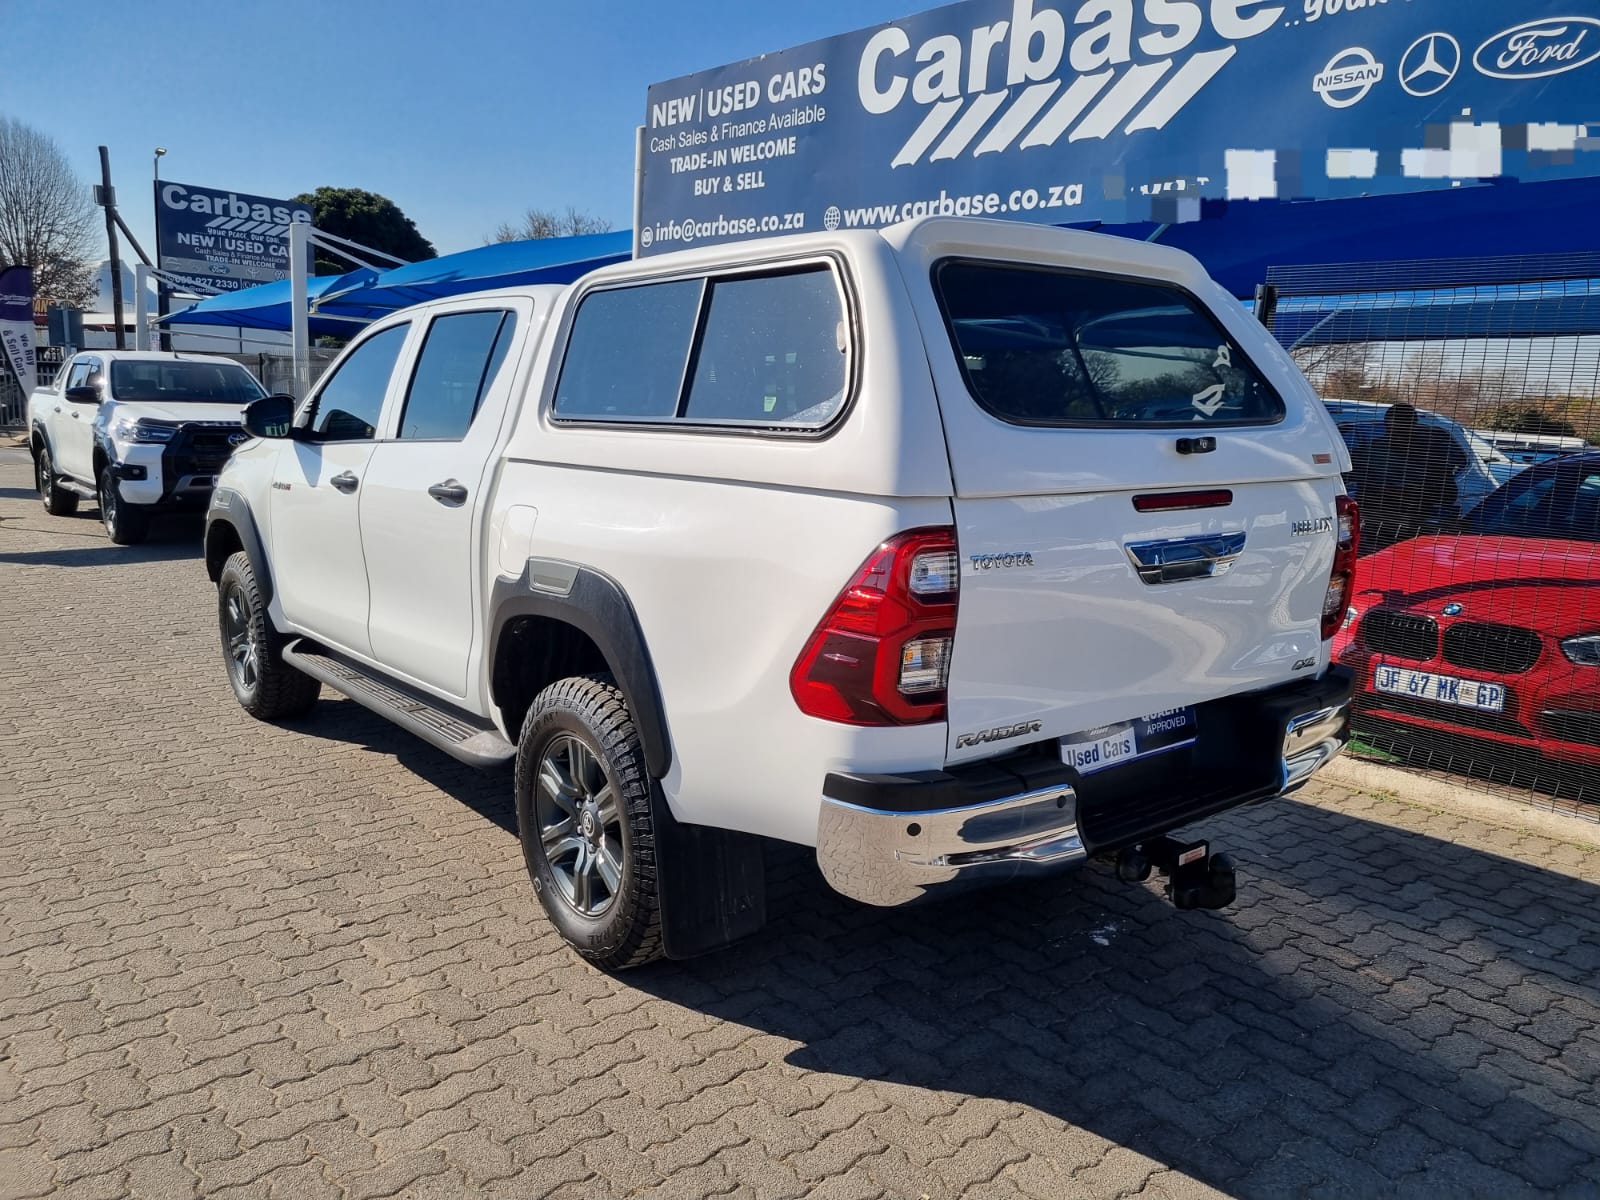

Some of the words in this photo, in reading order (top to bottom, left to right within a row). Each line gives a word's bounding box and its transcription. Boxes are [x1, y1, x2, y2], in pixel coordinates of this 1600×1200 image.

[1497, 26, 1588, 69] Ford
[1316, 67, 1380, 88] NISSAN
[652, 94, 697, 129] NEW
[707, 80, 761, 117] USED
[767, 63, 826, 103] CARS
[650, 135, 676, 153] Cash
[678, 130, 708, 148] Sales
[710, 125, 719, 142] &
[722, 121, 766, 140] Finance
[768, 104, 826, 131] Available
[670, 150, 728, 174] TRADE-IN
[731, 136, 797, 163] WELCOME
[694, 177, 721, 196] BUY
[723, 175, 733, 192] &
[736, 171, 765, 191] SELL
[162, 184, 312, 225] Carbase
[844, 183, 1084, 226] www.carbase.co.za
[655, 212, 805, 242] info@carbase.co.za
[177, 232, 215, 248] NEW
[225, 238, 265, 254] USED
[269, 244, 290, 258] CA
[194, 247, 211, 256] Cash
[205, 254, 241, 265] TRADE-IN
[242, 257, 277, 269] WELCOME
[215, 279, 239, 289] 2330
[6, 336, 20, 356] Sell
[14, 356, 27, 377] Cars
[25, 349, 35, 366] Buy
[970, 550, 1034, 571] TOYOTA
[1380, 669, 1400, 689] JF
[1408, 673, 1430, 695] 67
[1436, 678, 1459, 700] MK
[1476, 685, 1500, 705] GP
[956, 719, 1043, 749] RAIDER
[1146, 715, 1187, 736] APPROVED
[1067, 742, 1100, 768] Used
[1103, 738, 1131, 760] Cars
